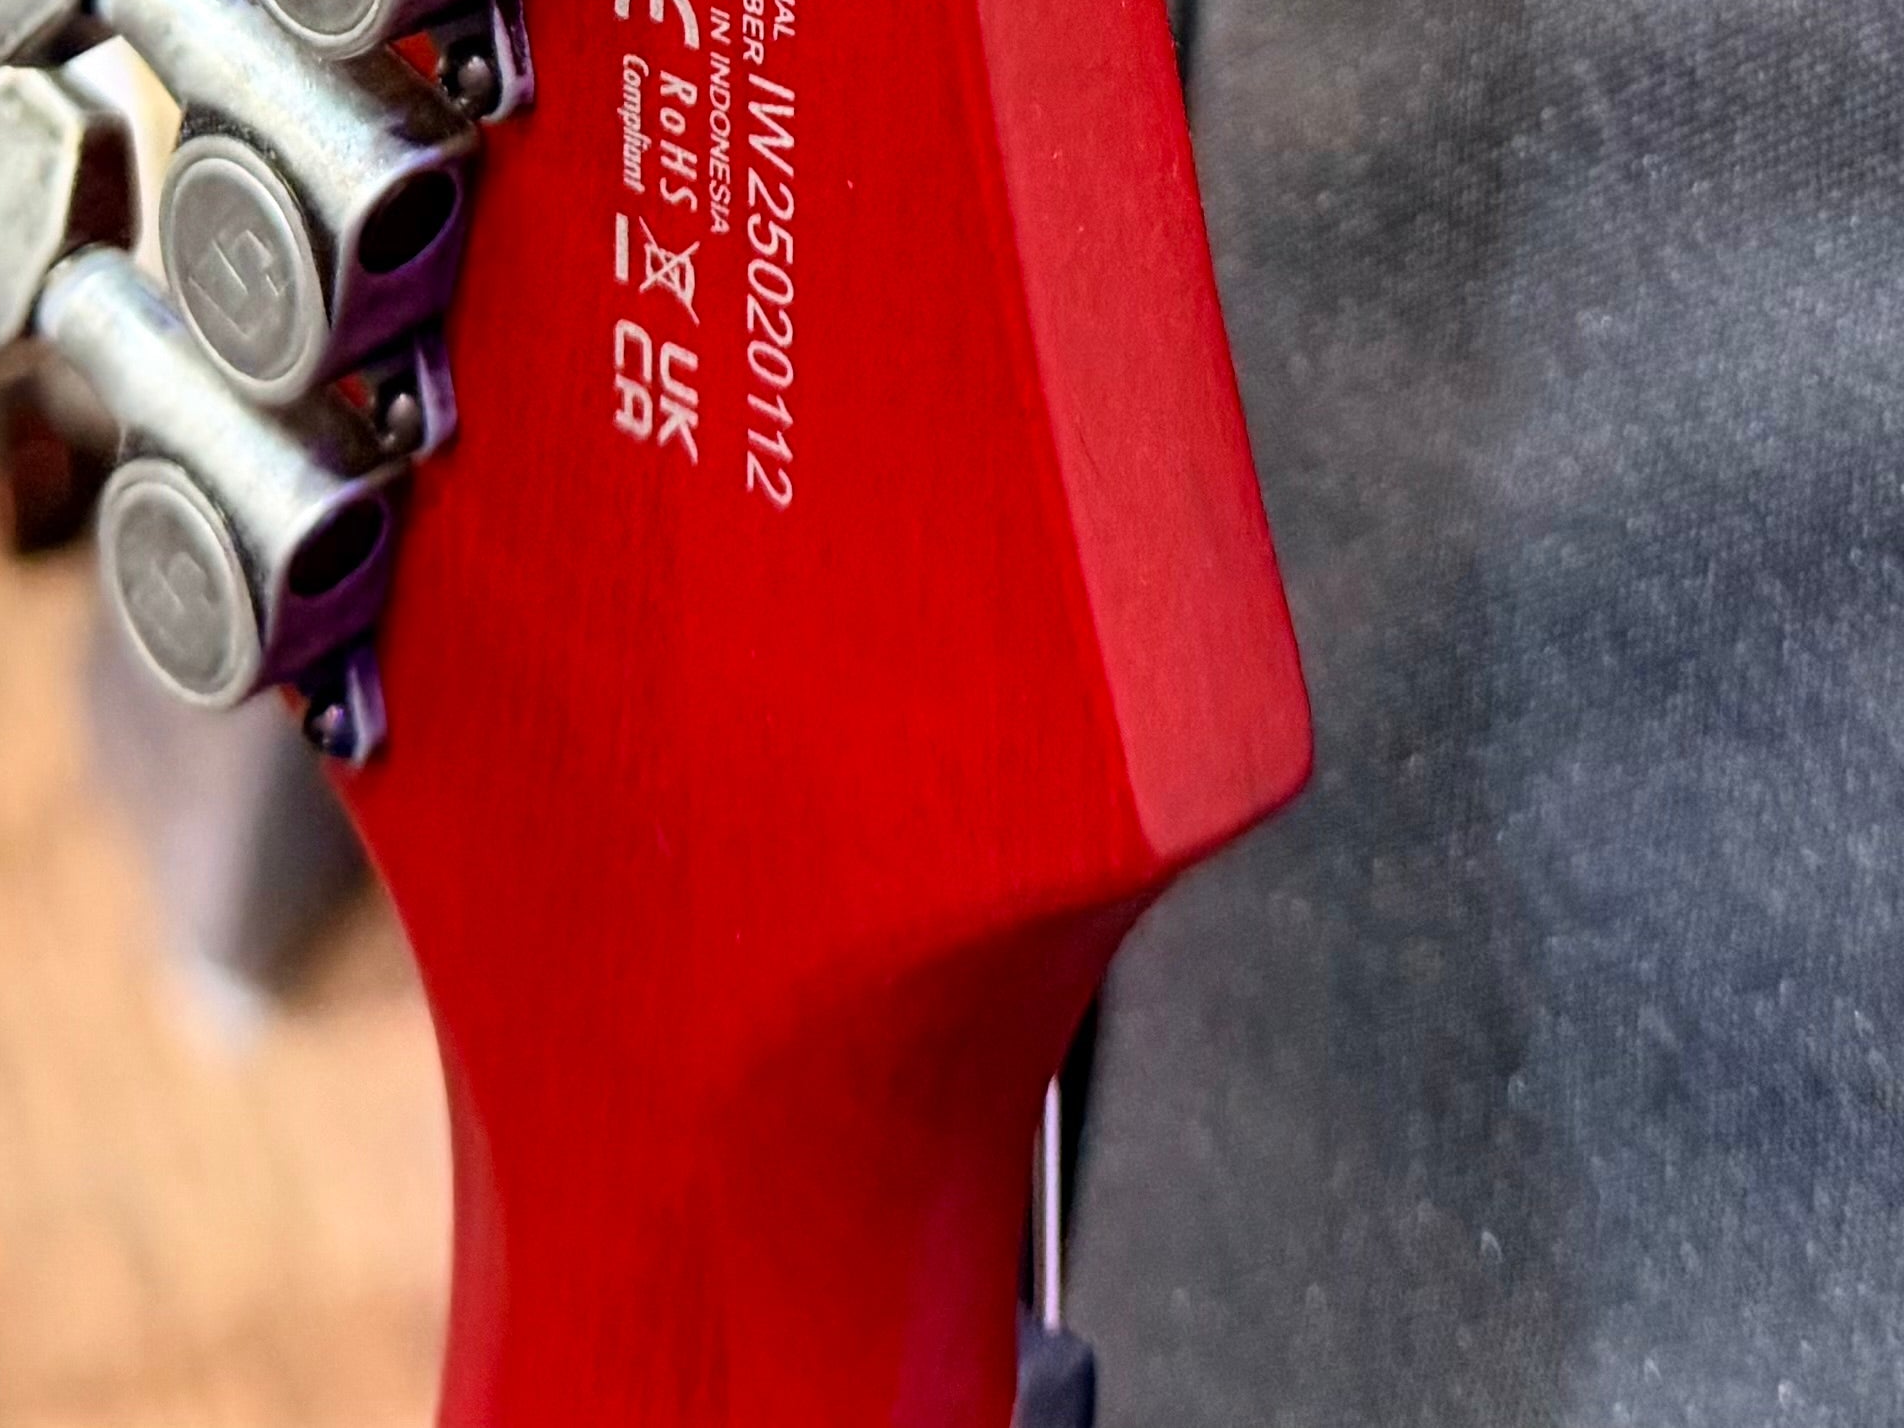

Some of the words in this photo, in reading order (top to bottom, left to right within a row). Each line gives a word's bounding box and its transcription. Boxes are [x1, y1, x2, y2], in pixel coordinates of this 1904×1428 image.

[709, 4, 731, 45] IN
[618, 53, 652, 194] Compliant
[659, 70, 698, 212] RoHS
[709, 51, 731, 235] INDONESIA
[746, 73, 795, 508] IW25020112
[614, 319, 653, 441] CA
[658, 341, 699, 465] UK
